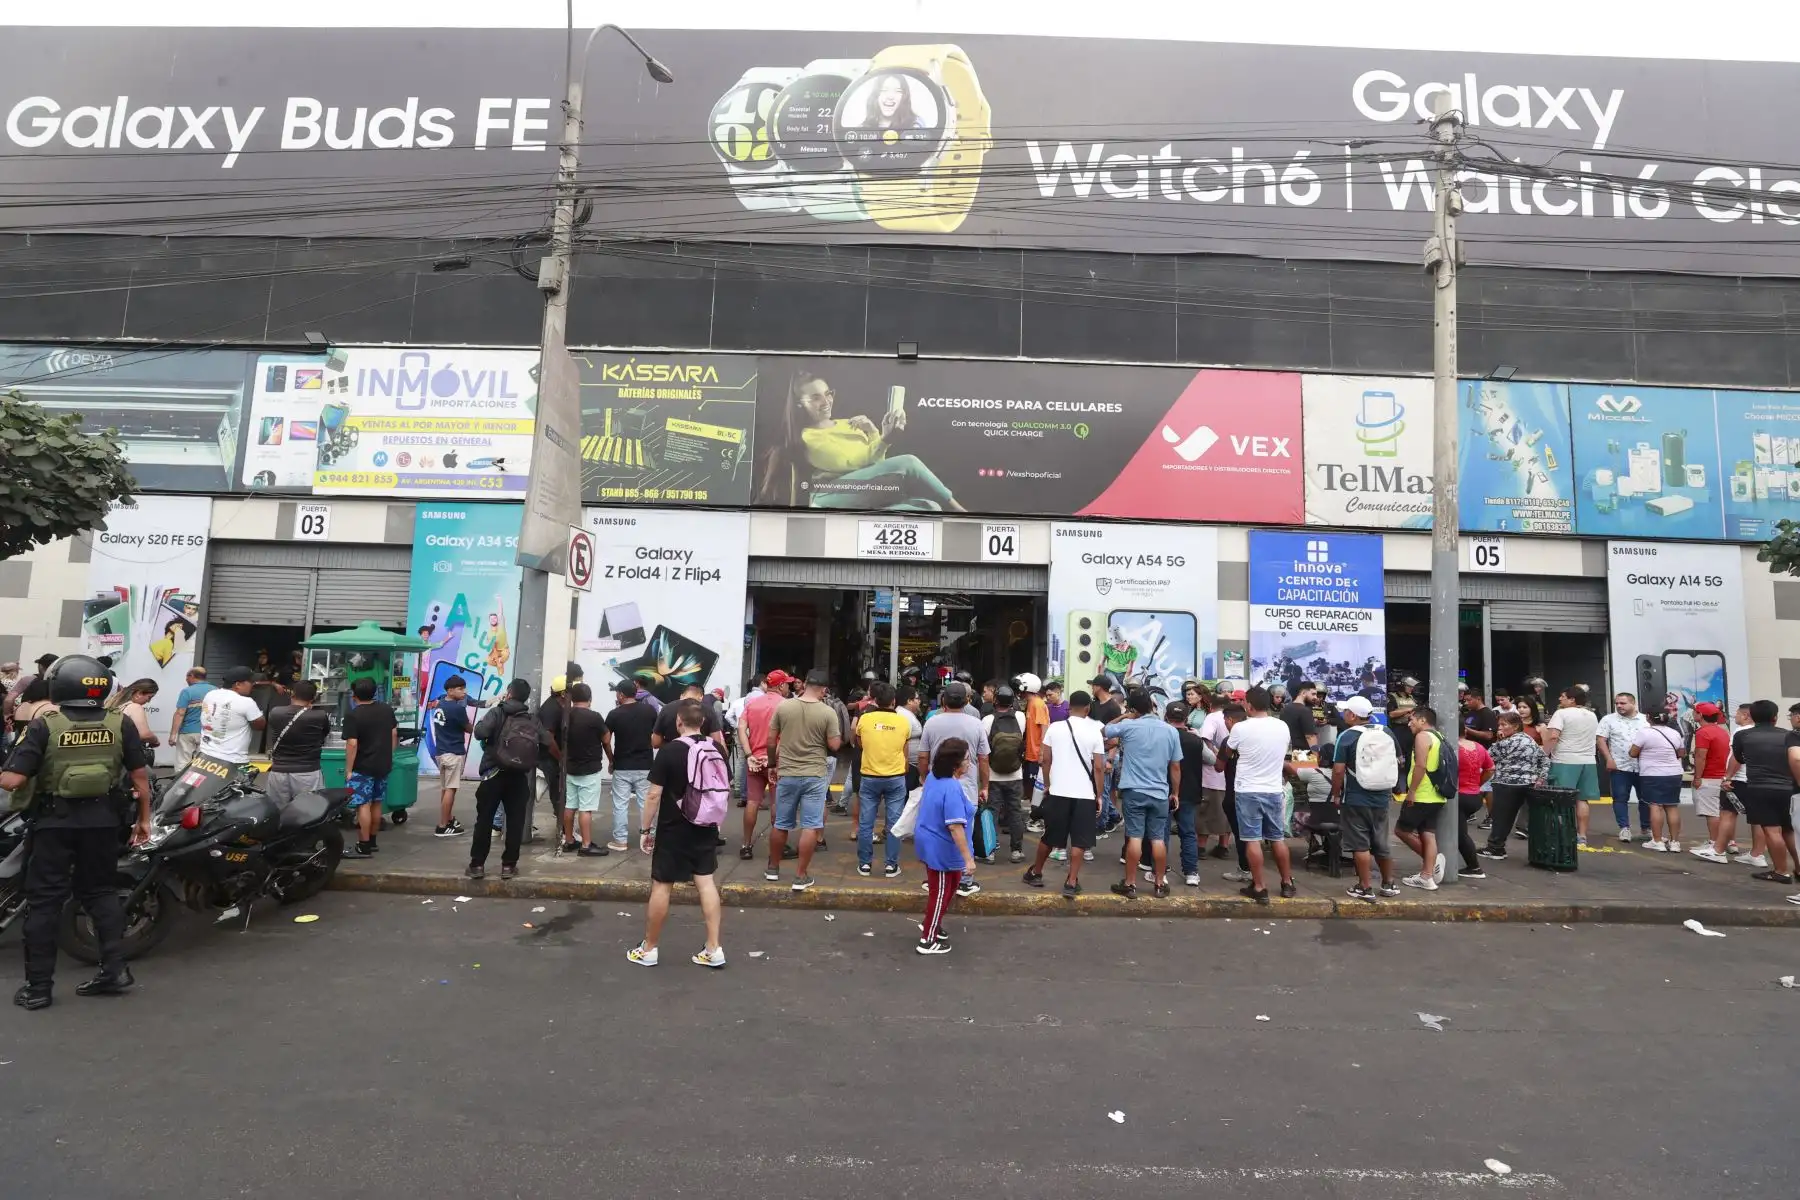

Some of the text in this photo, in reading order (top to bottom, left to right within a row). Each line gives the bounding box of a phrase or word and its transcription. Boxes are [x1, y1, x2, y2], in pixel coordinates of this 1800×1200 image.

[1352, 70, 1624, 149] Galaxy
[6, 96, 551, 168] Galaxy Buds FE
[656, 388, 703, 400] ORIGINALES
[430, 400, 518, 408] IMPORTACIONES
[917, 397, 1122, 413] ACCESORIOS PARA CELULARES
[362, 420, 397, 429] VENTAS
[400, 421, 410, 429] AL
[413, 421, 433, 429] POR
[436, 421, 470, 430] MAYOR
[482, 422, 517, 431] MENOR
[951, 420, 966, 428] Con
[1011, 421, 1059, 430] QUALCOMM
[984, 429, 1044, 438] QUICK CHARGE
[382, 436, 492, 446] REPUESTOS EN GENERAL
[1230, 435, 1292, 458] VEX
[329, 474, 393, 484] 944 821 855
[601, 488, 624, 498] STAND
[1484, 497, 1505, 505] Tienda
[301, 505, 328, 513] PUERTA
[422, 511, 466, 520] SAMSUNG
[593, 517, 637, 526] SAMSUNG
[301, 514, 325, 535] 03
[875, 529, 917, 545] 428
[1056, 529, 1103, 538] SAMSUNG
[100, 532, 204, 548] Galaxy S20 FE 5G
[425, 534, 475, 550] Galaxy
[477, 536, 501, 546] A34
[988, 535, 1014, 556] 04
[635, 546, 693, 565] Galaxy
[1475, 545, 1500, 567] 05
[1612, 547, 1657, 556] SAMSUNG
[1081, 552, 1185, 569] Galaxy A54 5G
[605, 565, 721, 585] Z Fold4 Z Flip4
[1627, 573, 1723, 589] Galaxy A14 5G
[1286, 576, 1351, 587] CENTRO DE
[1278, 587, 1359, 603] CAPACITACIÓN
[1264, 608, 1372, 621] CURSO REPARACIÓN
[1279, 620, 1359, 632] DE CELULARES
[82, 677, 108, 686] GIR
[62, 730, 111, 746] POLICIA
